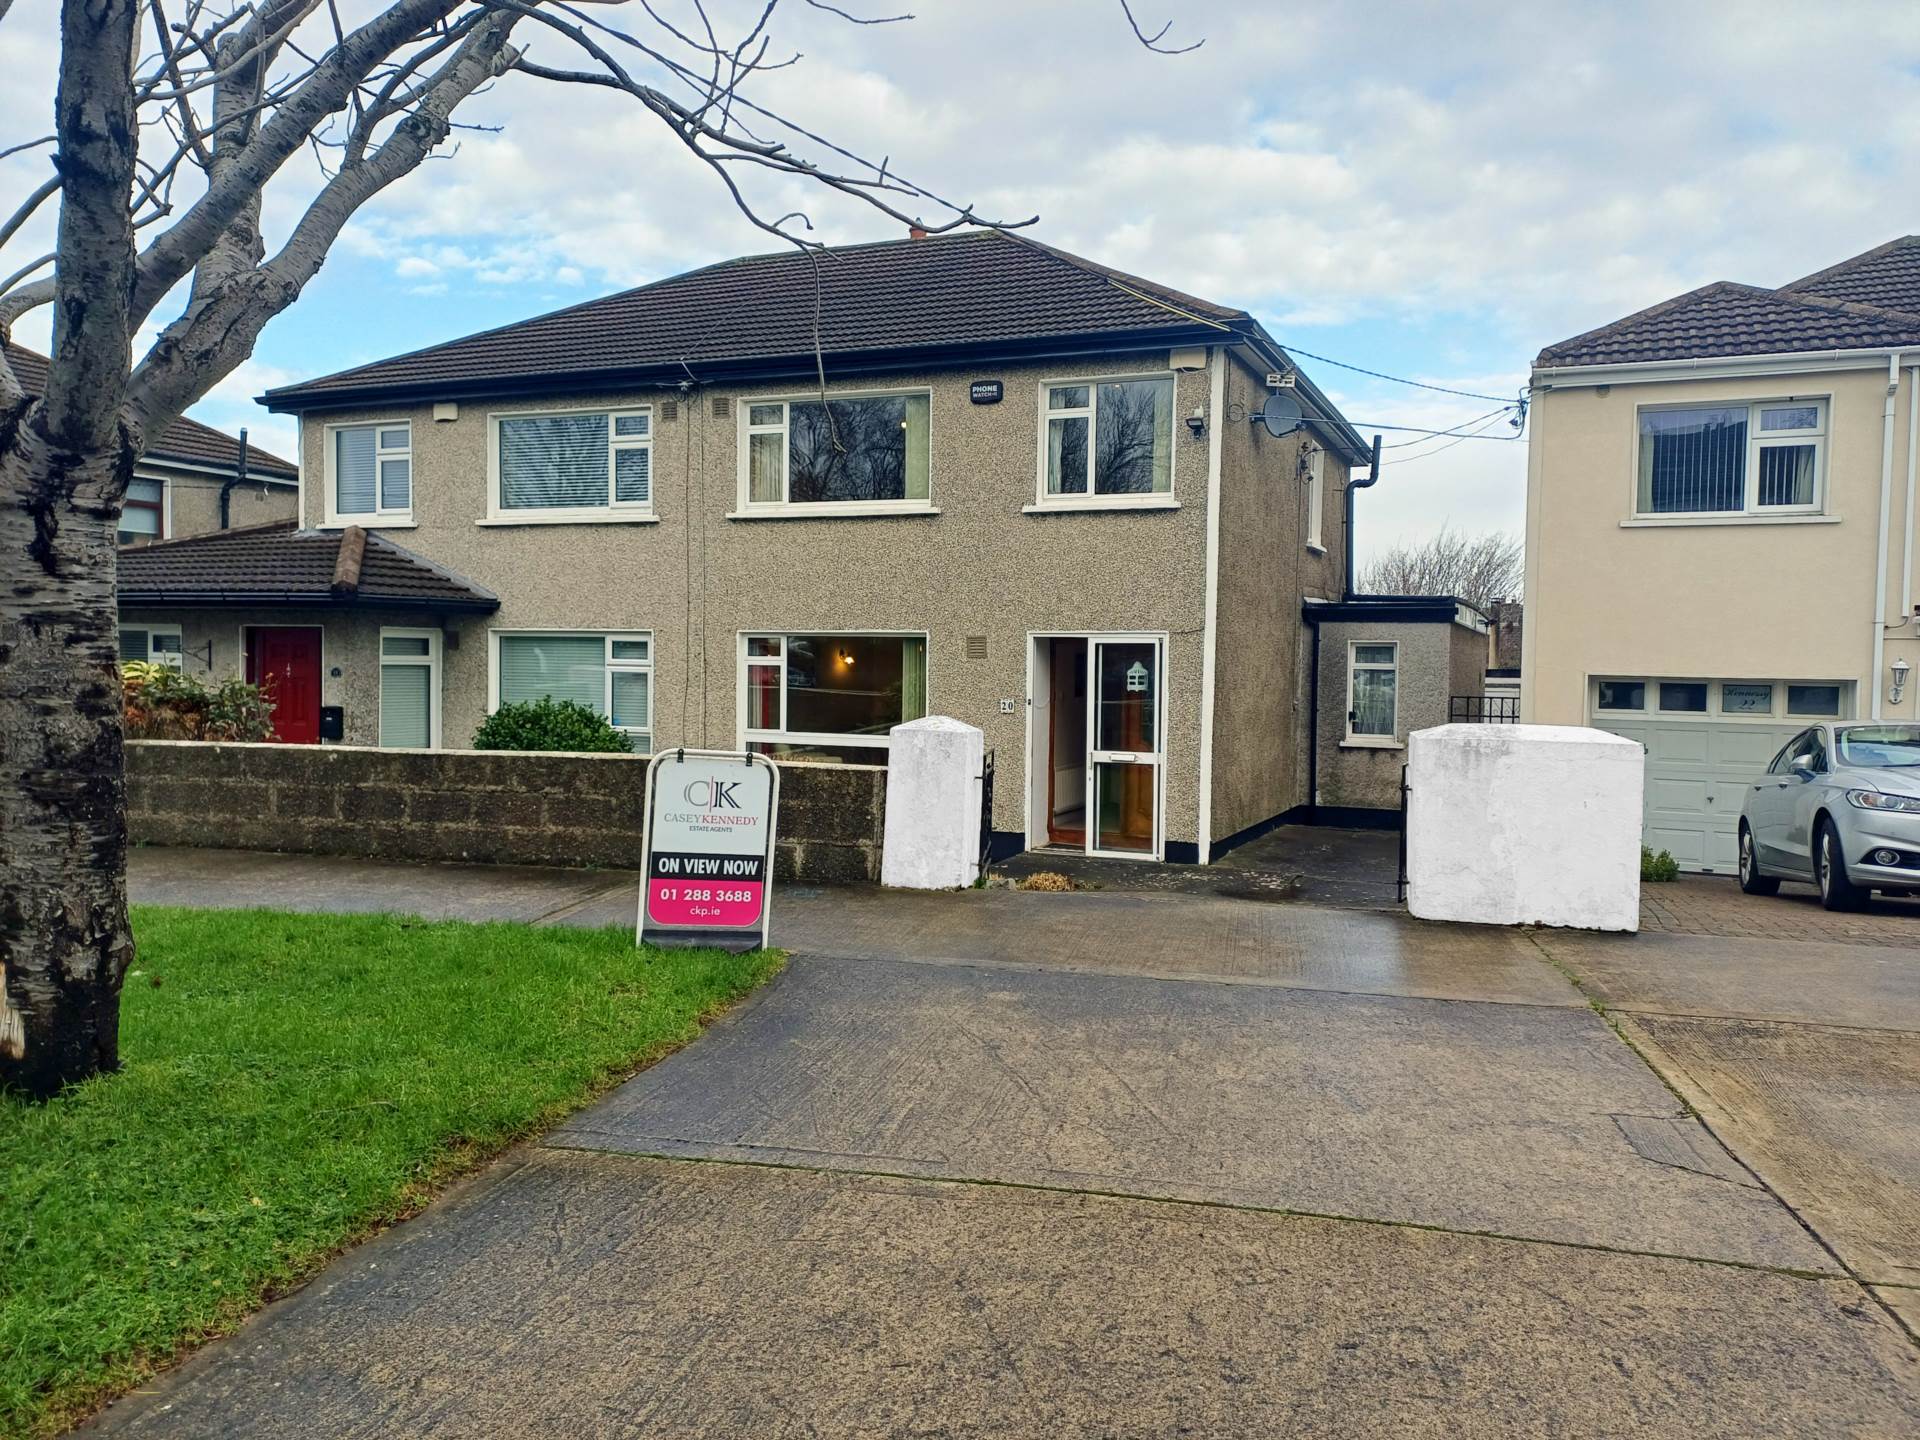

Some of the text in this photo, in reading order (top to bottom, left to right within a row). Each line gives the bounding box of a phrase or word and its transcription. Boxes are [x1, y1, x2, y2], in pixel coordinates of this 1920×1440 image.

[1002, 702, 1013, 710] 20
[1738, 699, 1755, 710] 22
[658, 858, 758, 875] ON VIEW NOW
[660, 888, 752, 902] 01 288 3688
[690, 906, 720, 917] ckp.ie
